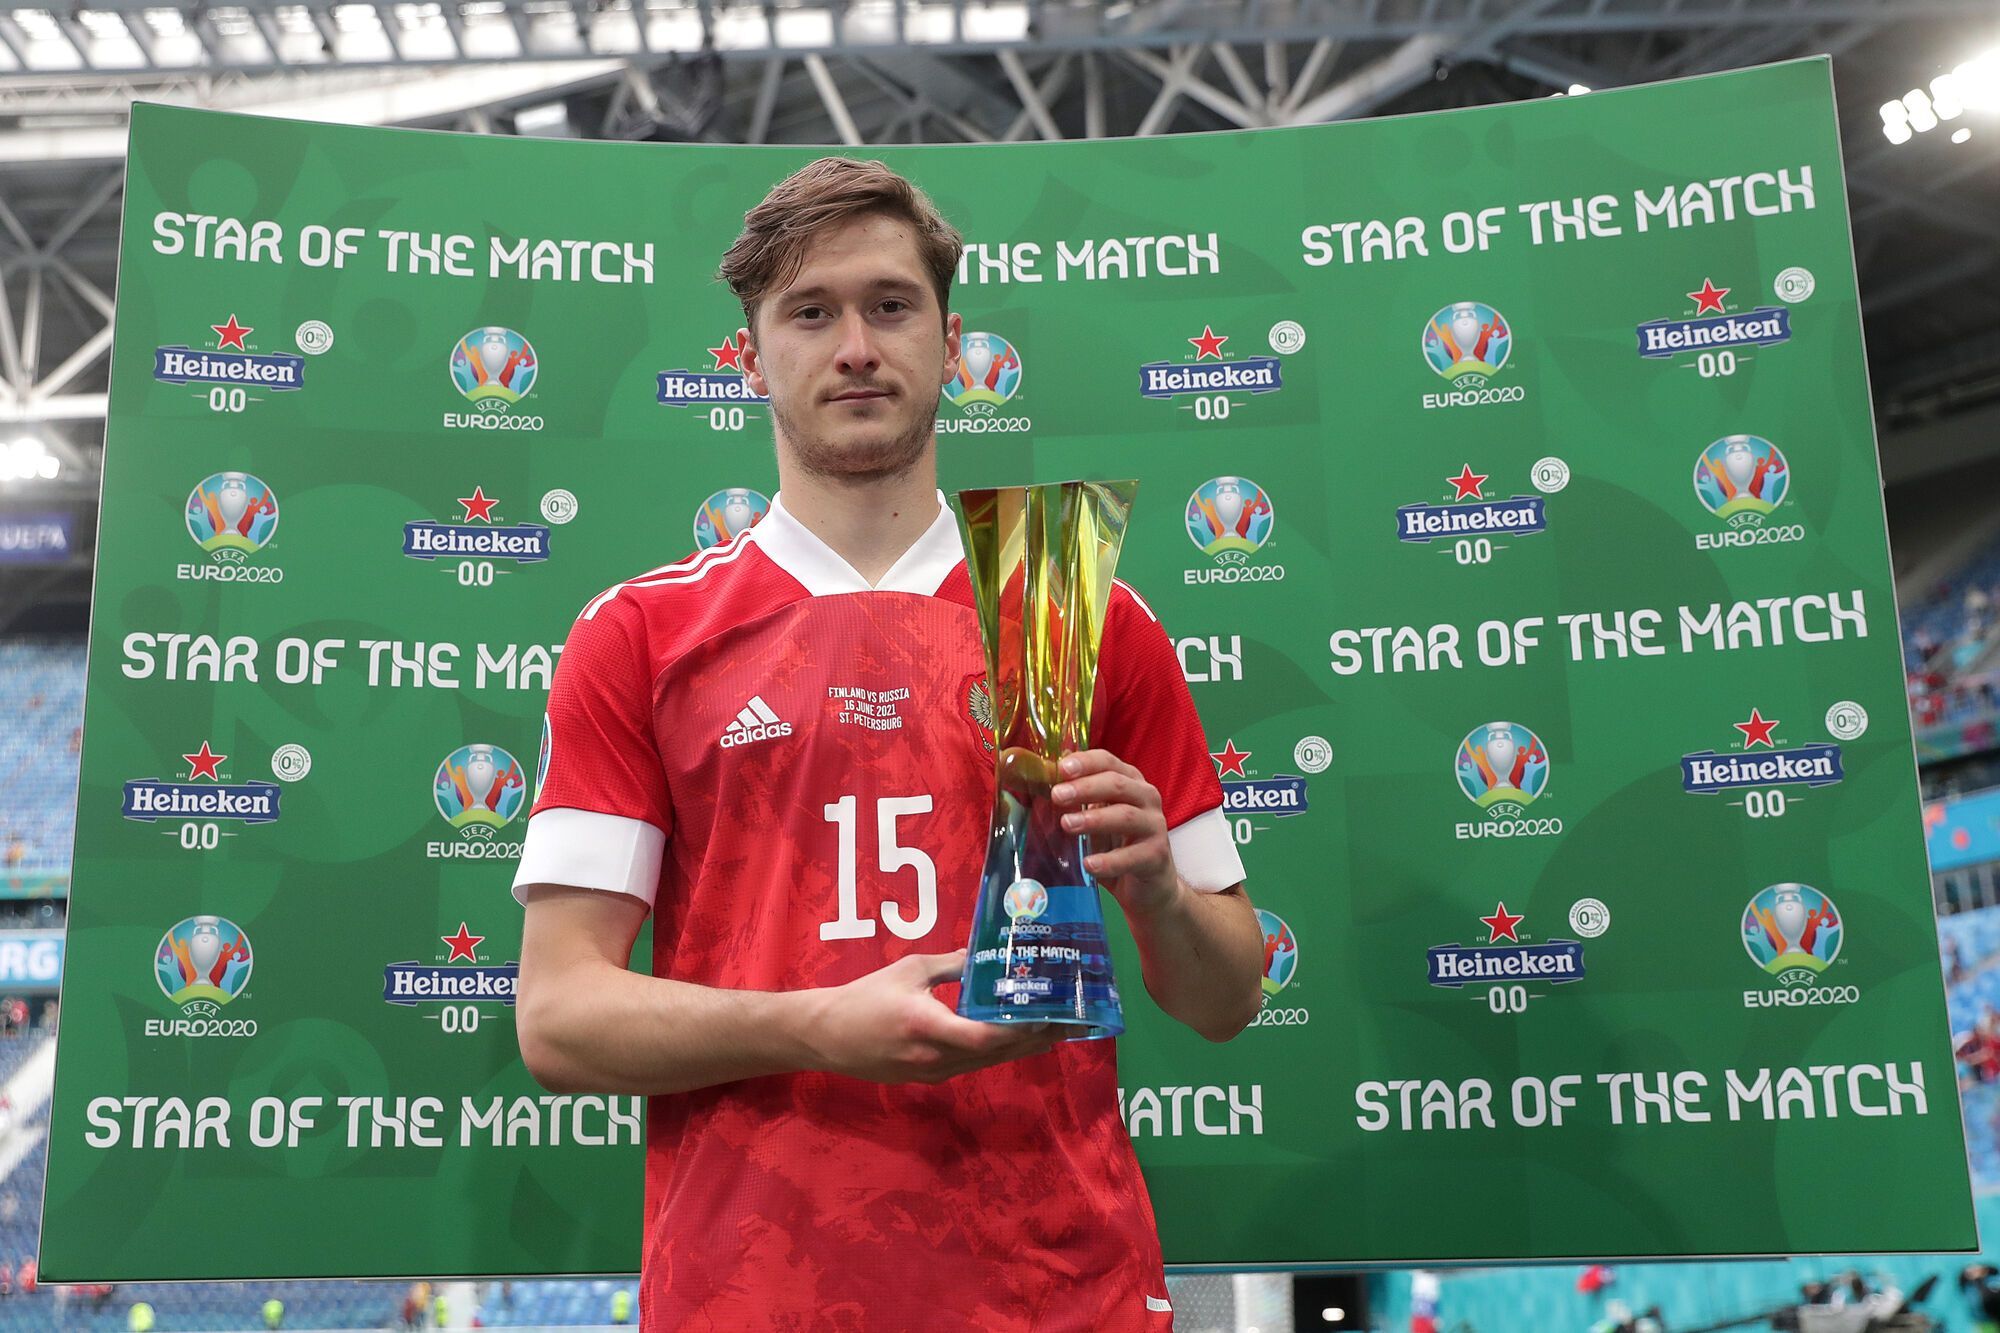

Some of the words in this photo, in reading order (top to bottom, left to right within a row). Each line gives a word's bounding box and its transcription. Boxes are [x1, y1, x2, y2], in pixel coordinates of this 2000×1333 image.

[1302, 217, 1428, 265] STAR
[1443, 207, 1505, 253] OF
[1519, 195, 1621, 244] THE
[1634, 166, 1815, 232] MATCH
[153, 212, 282, 263] STAR
[300, 225, 365, 268] OF
[379, 230, 474, 276] THE
[490, 237, 653, 283] MATCH
[1057, 233, 1219, 281] MATCH
[1646, 317, 1781, 351] Heineken
[163, 353, 295, 382] Heineken
[1698, 351, 1735, 377] 0.0
[1148, 367, 1273, 391] Heineken
[1455, 376, 1485, 388] UEFA
[210, 387, 245, 412] 0.0
[477, 401, 509, 413] UEFA
[964, 404, 995, 416] UEFA
[1196, 396, 1229, 419] 0.0
[1423, 386, 1524, 409] EURO2020
[444, 413, 543, 430] EURO2020
[711, 408, 744, 430] 0.0
[935, 418, 1030, 433] EURO2020
[1405, 504, 1536, 534] Heineken
[1729, 513, 1762, 527] UEFA
[412, 528, 541, 554] Heineken
[1696, 524, 1804, 550] EURO2020
[212, 551, 244, 562] UEFA
[1216, 553, 1246, 564] UEFA
[1455, 539, 1492, 565] 0.0
[177, 564, 283, 584] EURO2020
[459, 561, 493, 586] 0.0
[1184, 564, 1284, 584] EURO2020
[1330, 624, 1462, 674] STAR
[1478, 617, 1543, 666] OF
[1558, 609, 1665, 660] THE
[1679, 590, 1867, 652] MATCH
[122, 633, 258, 682] STAR
[276, 638, 345, 684] OF
[360, 641, 460, 688] THE
[1168, 635, 1242, 682] CH
[828, 687, 866, 700] FINLAND
[867, 690, 877, 703] VS
[879, 687, 910, 703] RUSSIA
[844, 700, 855, 711] 16
[856, 701, 875, 716] JUNE
[876, 704, 896, 717] 2021
[839, 712, 853, 724] ST.
[853, 713, 902, 731] PETERSBURG
[720, 721, 793, 748] adidas
[1690, 754, 1833, 785] Heineken
[132, 787, 270, 815] Heineken
[1489, 805, 1521, 817] UEFA
[1746, 790, 1785, 817] 0.0
[181, 823, 218, 849] 0.0
[462, 826, 493, 839] UEFA
[1456, 818, 1562, 839] EURO2020
[820, 795, 937, 940] 15
[975, 949, 997, 964] STAR
[1016, 946, 1039, 957] THE
[1041, 946, 1080, 961] MATCH
[1436, 949, 1575, 979] Heineken
[1779, 972, 1814, 985] UEFA
[183, 1003, 217, 1016] UEFA
[1489, 986, 1526, 1013] 0.0
[1744, 986, 1859, 1008] EURO2020
[145, 1020, 257, 1036] EURO2020
[442, 1006, 478, 1033] 0.0
[1356, 1079, 1495, 1131] STAR
[1512, 1075, 1581, 1126] OF
[1597, 1071, 1711, 1124] THE
[1726, 1062, 1927, 1120] MATCH
[85, 1097, 230, 1148] STAR
[250, 1097, 322, 1147] OF
[338, 1097, 443, 1147] THE
[461, 1096, 640, 1146] MATCH
[1117, 1085, 1263, 1137] ATCH
